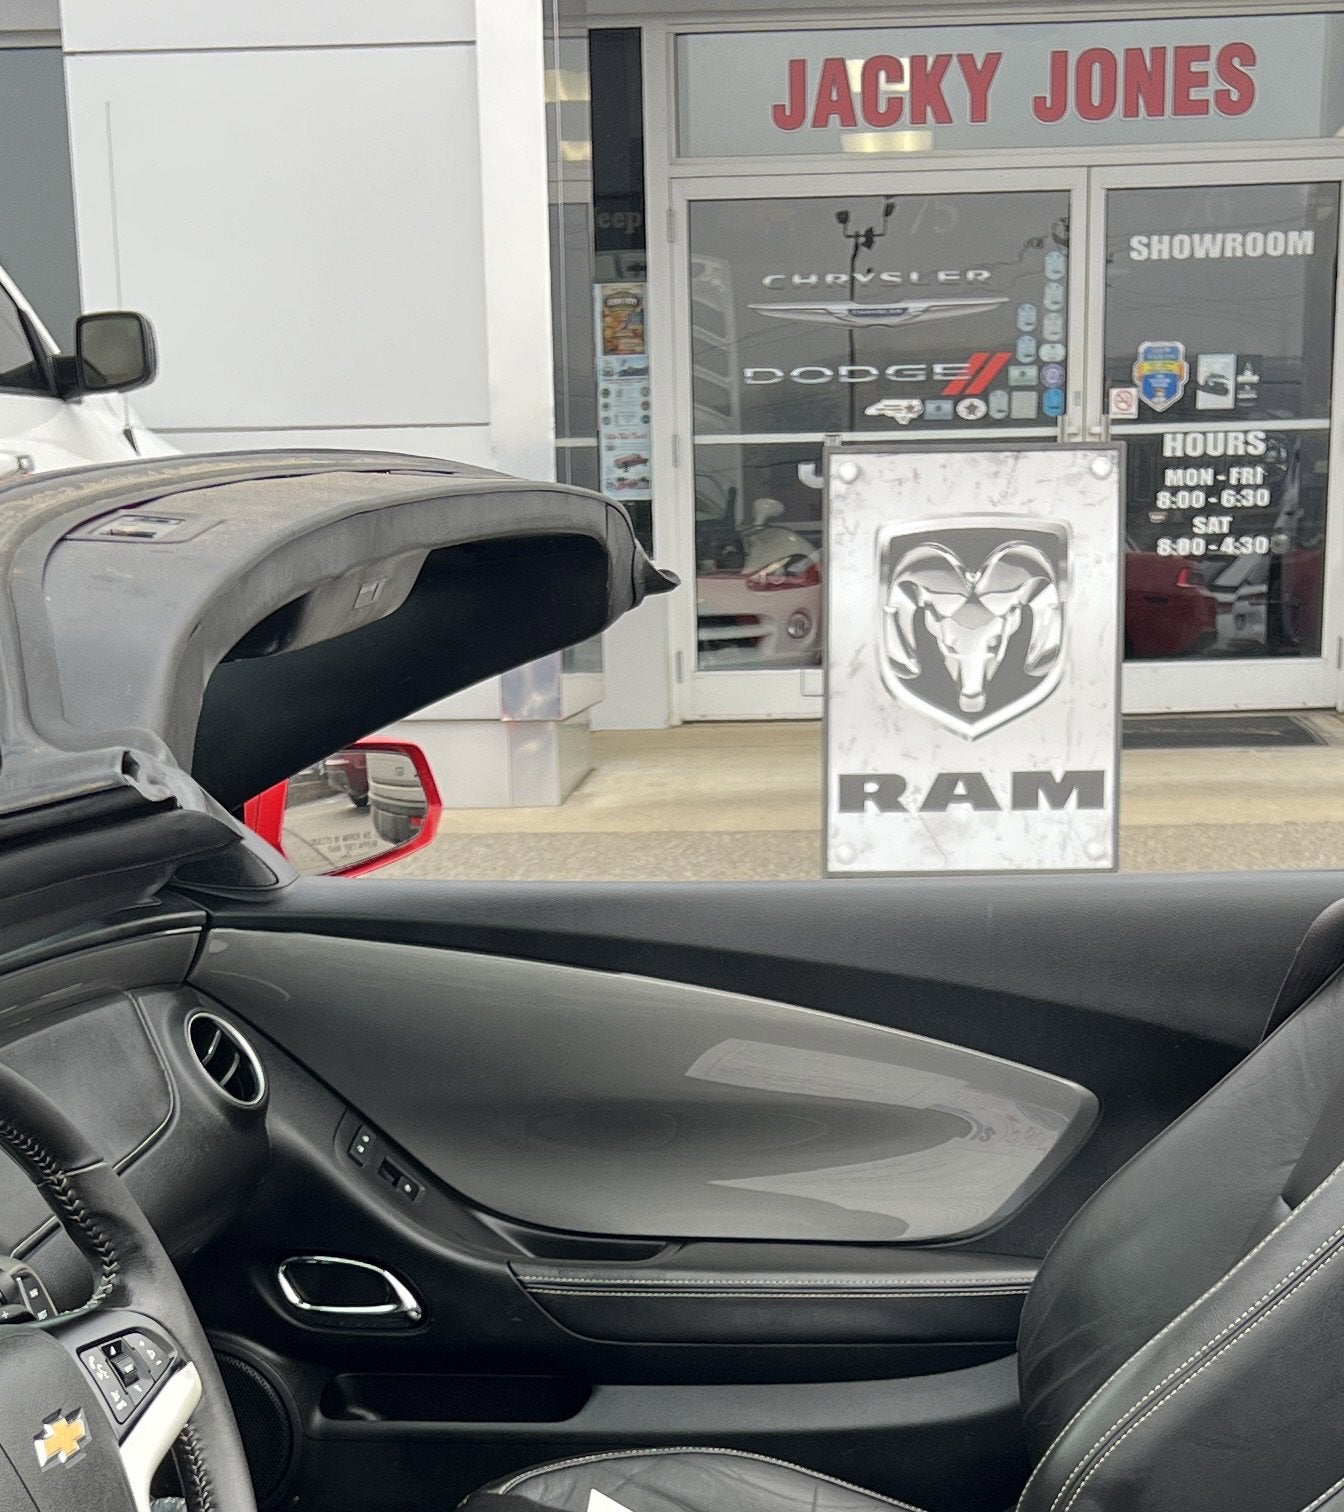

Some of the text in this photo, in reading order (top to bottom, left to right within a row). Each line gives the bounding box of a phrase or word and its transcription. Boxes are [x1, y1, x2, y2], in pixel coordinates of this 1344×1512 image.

[771, 41, 1257, 131] JACKY JONES
[599, 211, 642, 235] eep
[1129, 229, 1315, 261] SHOWROOM
[761, 269, 992, 290] CHRYSLER
[743, 363, 972, 385] DODGE
[1162, 431, 1267, 458] HOURS
[1164, 467, 1214, 487] MON
[1229, 465, 1265, 486] FRI
[1156, 490, 1205, 510] 8:00
[1220, 488, 1271, 508] 6:30
[1192, 515, 1233, 535] SAT
[1156, 538, 1205, 556] 8:00
[1220, 536, 1269, 555] 4:30
[838, 768, 1106, 814] RAM
